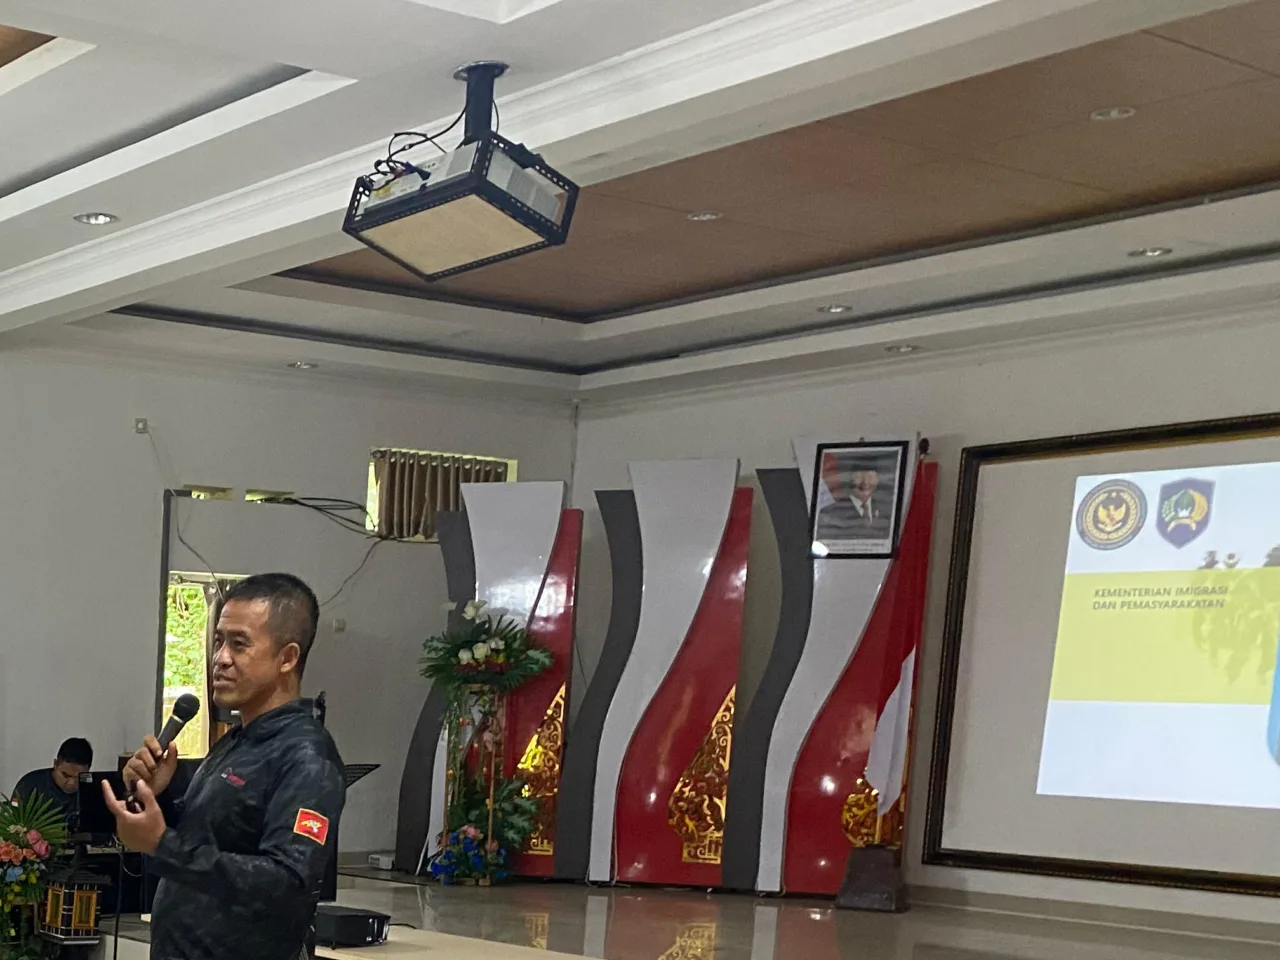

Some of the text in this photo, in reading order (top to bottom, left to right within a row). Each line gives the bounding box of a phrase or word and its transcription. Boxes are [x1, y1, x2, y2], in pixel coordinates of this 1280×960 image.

[1094, 586, 1228, 598] KEMENTERIAN IMIGRASI
[1092, 599, 1226, 610] DAN PEMASYARAKATAN
